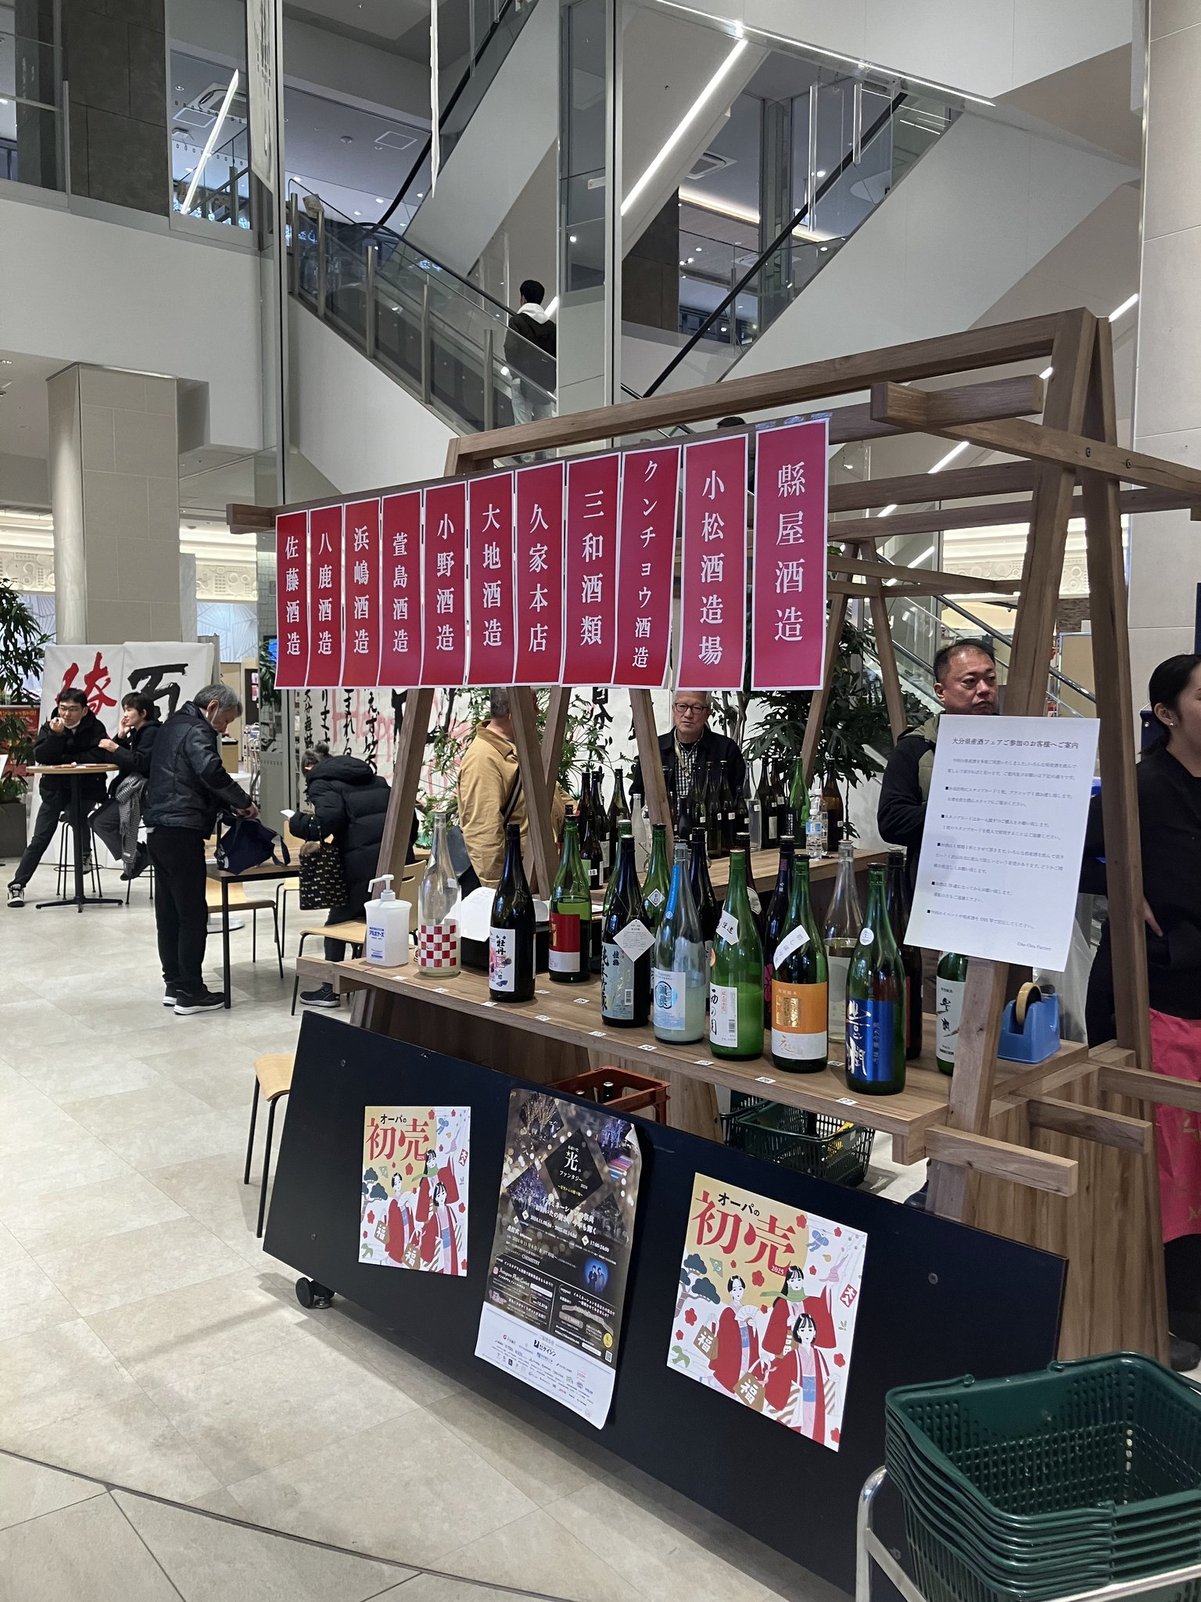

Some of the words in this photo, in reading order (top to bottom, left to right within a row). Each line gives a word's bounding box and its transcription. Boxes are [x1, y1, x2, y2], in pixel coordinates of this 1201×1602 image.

[285, 535, 301, 656] 佐藤酒造
[318, 532, 332, 655] 八鹿酒造
[353, 525, 369, 654] 浜嶋酒造
[392, 532, 409, 653] 萱島酒造
[436, 513, 455, 651] 小野酒造
[481, 503, 502, 648] 大地酒造
[528, 503, 549, 653] 久家本店
[580, 489, 604, 646] 三和酒類
[632, 460, 658, 668] クンチョウ酒造
[698, 470, 725, 666] 小松酒造場
[774, 461, 806, 642] 縣屋酒造
[366, 1117, 430, 1162] 初売
[380, 1113, 407, 1124] オーパの
[692, 1190, 796, 1277] 初売
[718, 1192, 761, 1217] オーパの
[771, 1265, 785, 1275] 2025
[698, 1331, 714, 1352] 福
[739, 1376, 759, 1403] 福
